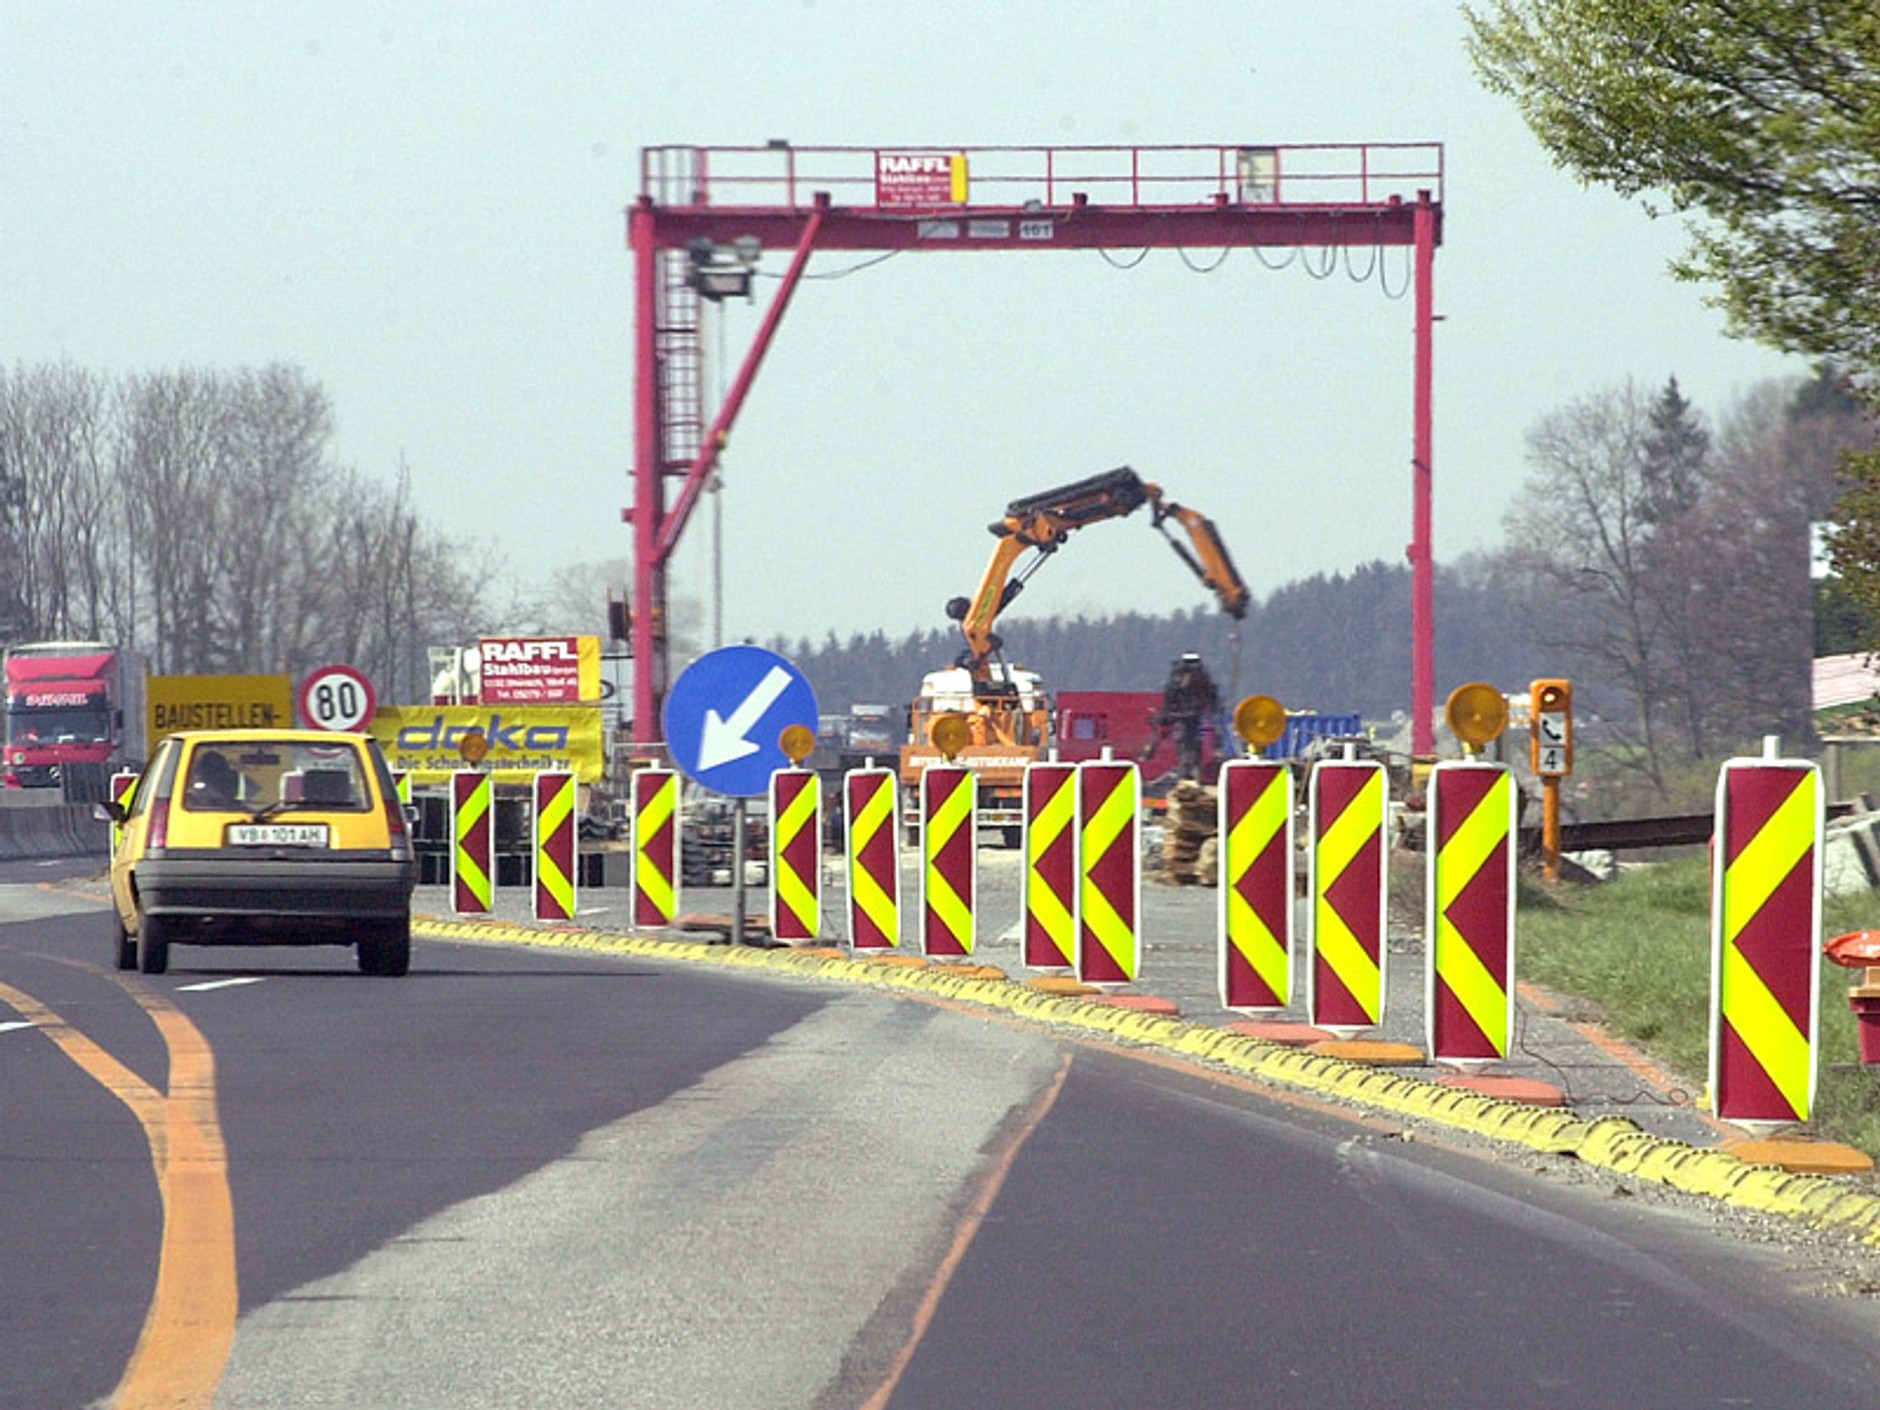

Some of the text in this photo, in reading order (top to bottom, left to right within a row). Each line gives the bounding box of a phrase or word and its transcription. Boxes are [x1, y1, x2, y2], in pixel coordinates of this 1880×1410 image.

[880, 157, 951, 173] RAFFL
[482, 641, 578, 661] RAFFL
[484, 662, 552, 676] Stahlbau
[317, 682, 358, 722] 80
[154, 702, 282, 730] BAUSTELLEN-
[397, 714, 570, 750] doka
[397, 755, 420, 769] Die
[1543, 749, 1558, 770] 4
